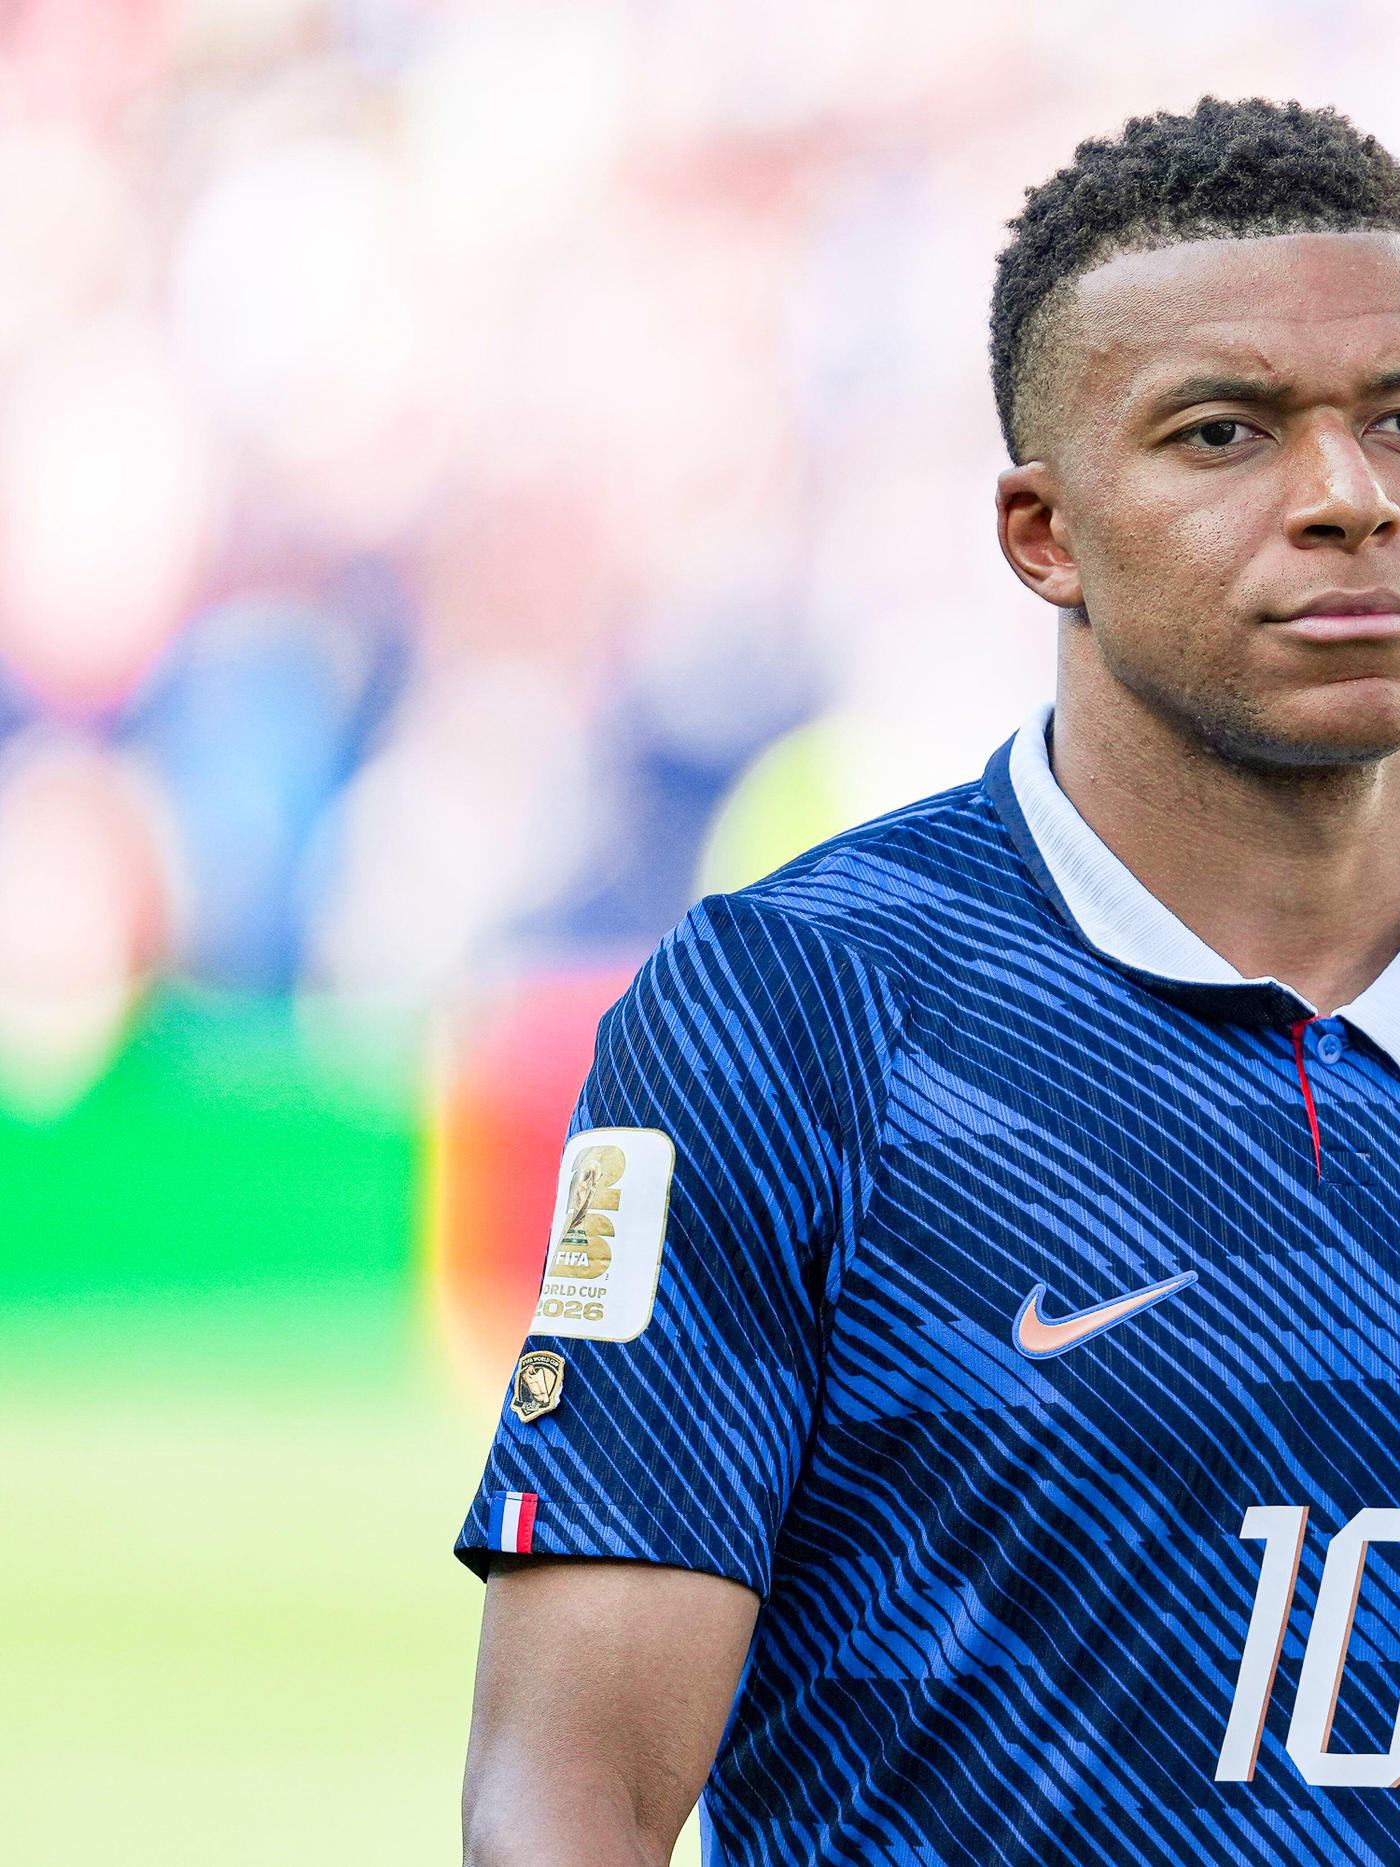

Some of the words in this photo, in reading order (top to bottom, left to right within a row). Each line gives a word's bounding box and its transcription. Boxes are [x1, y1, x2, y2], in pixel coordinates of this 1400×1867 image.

[555, 1251, 589, 1267] FIFA
[543, 1284, 577, 1297] ORLD
[579, 1286, 608, 1299] CUP
